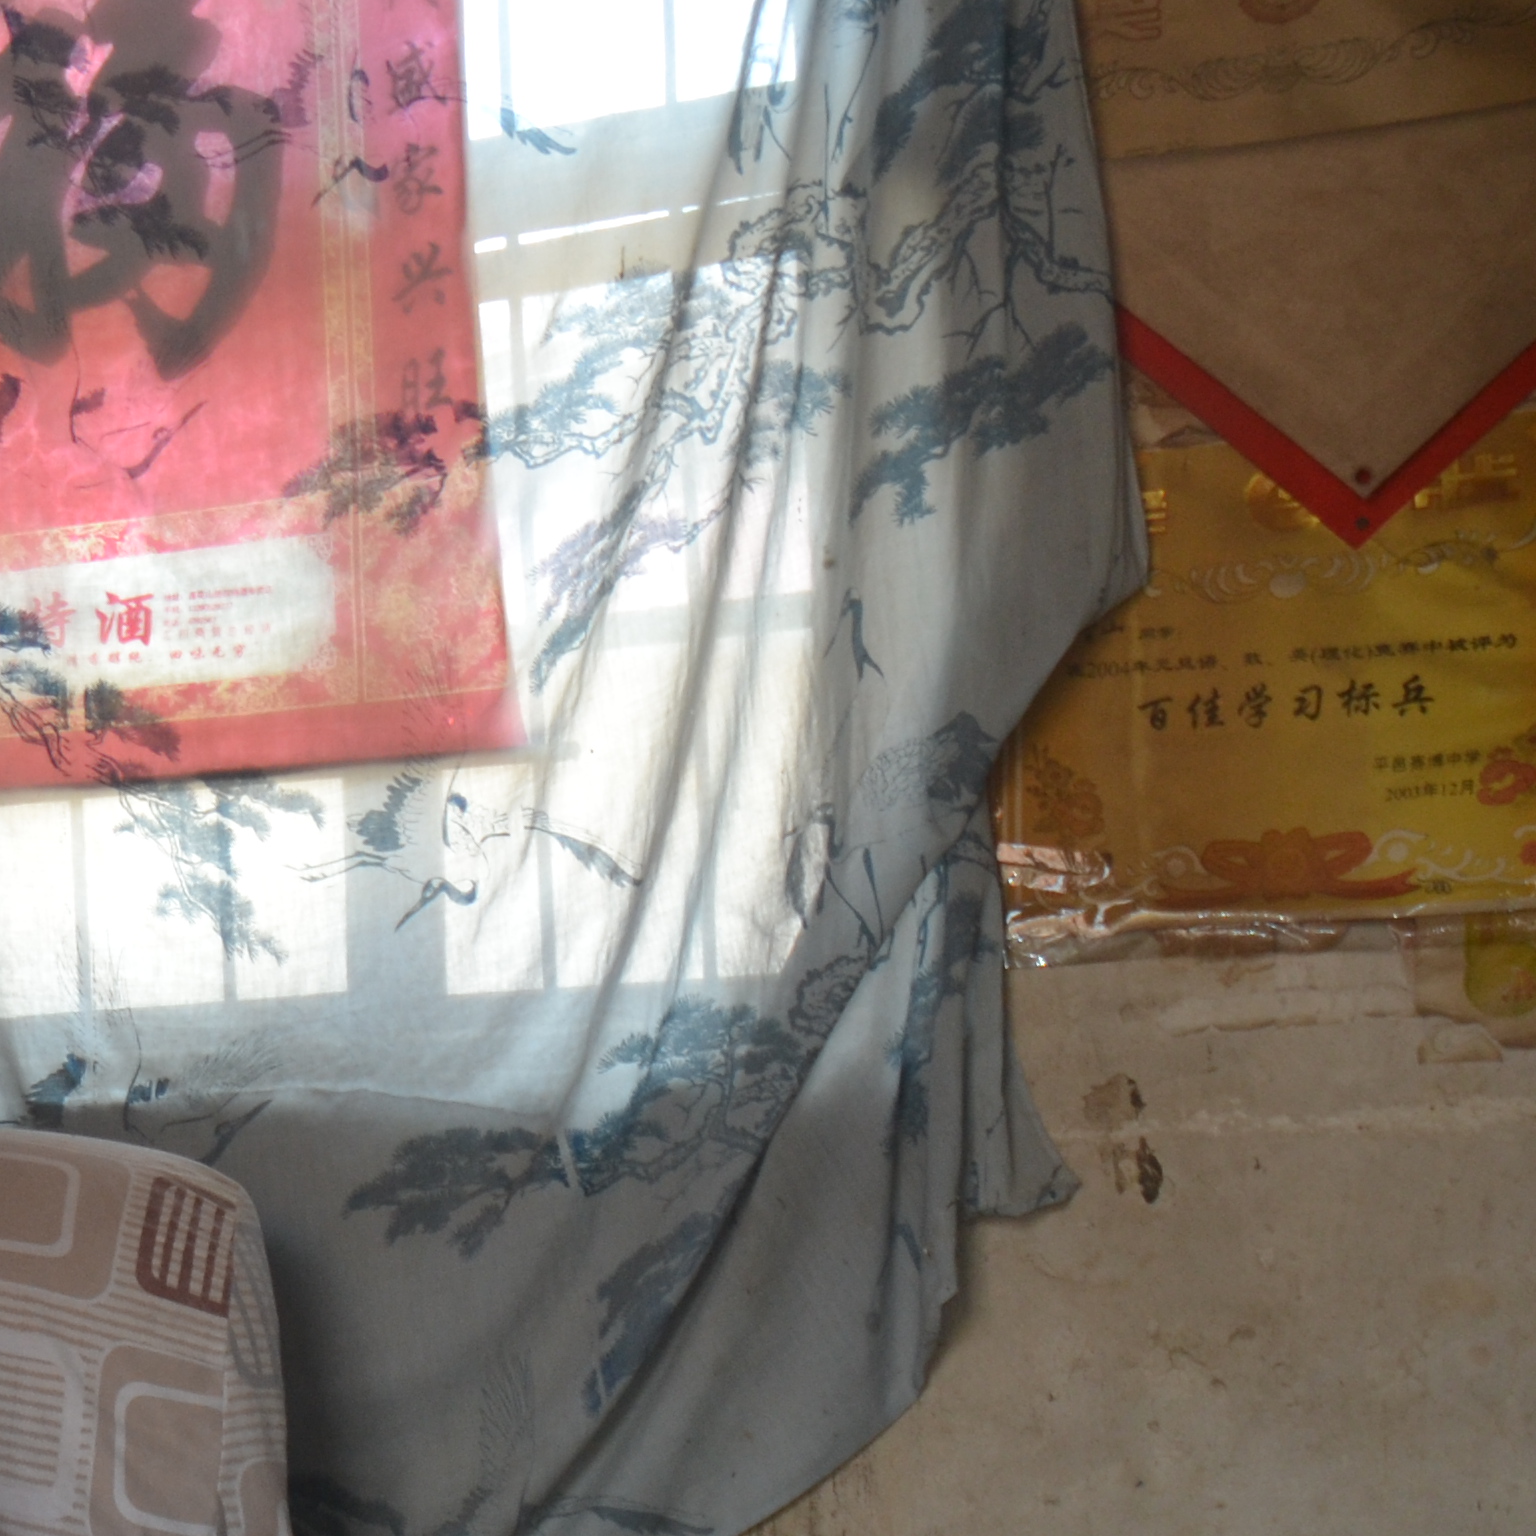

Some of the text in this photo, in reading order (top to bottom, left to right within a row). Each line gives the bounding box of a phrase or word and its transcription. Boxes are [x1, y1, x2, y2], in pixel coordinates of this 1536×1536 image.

[1137, 674, 1436, 733] 百佳学习标兵
